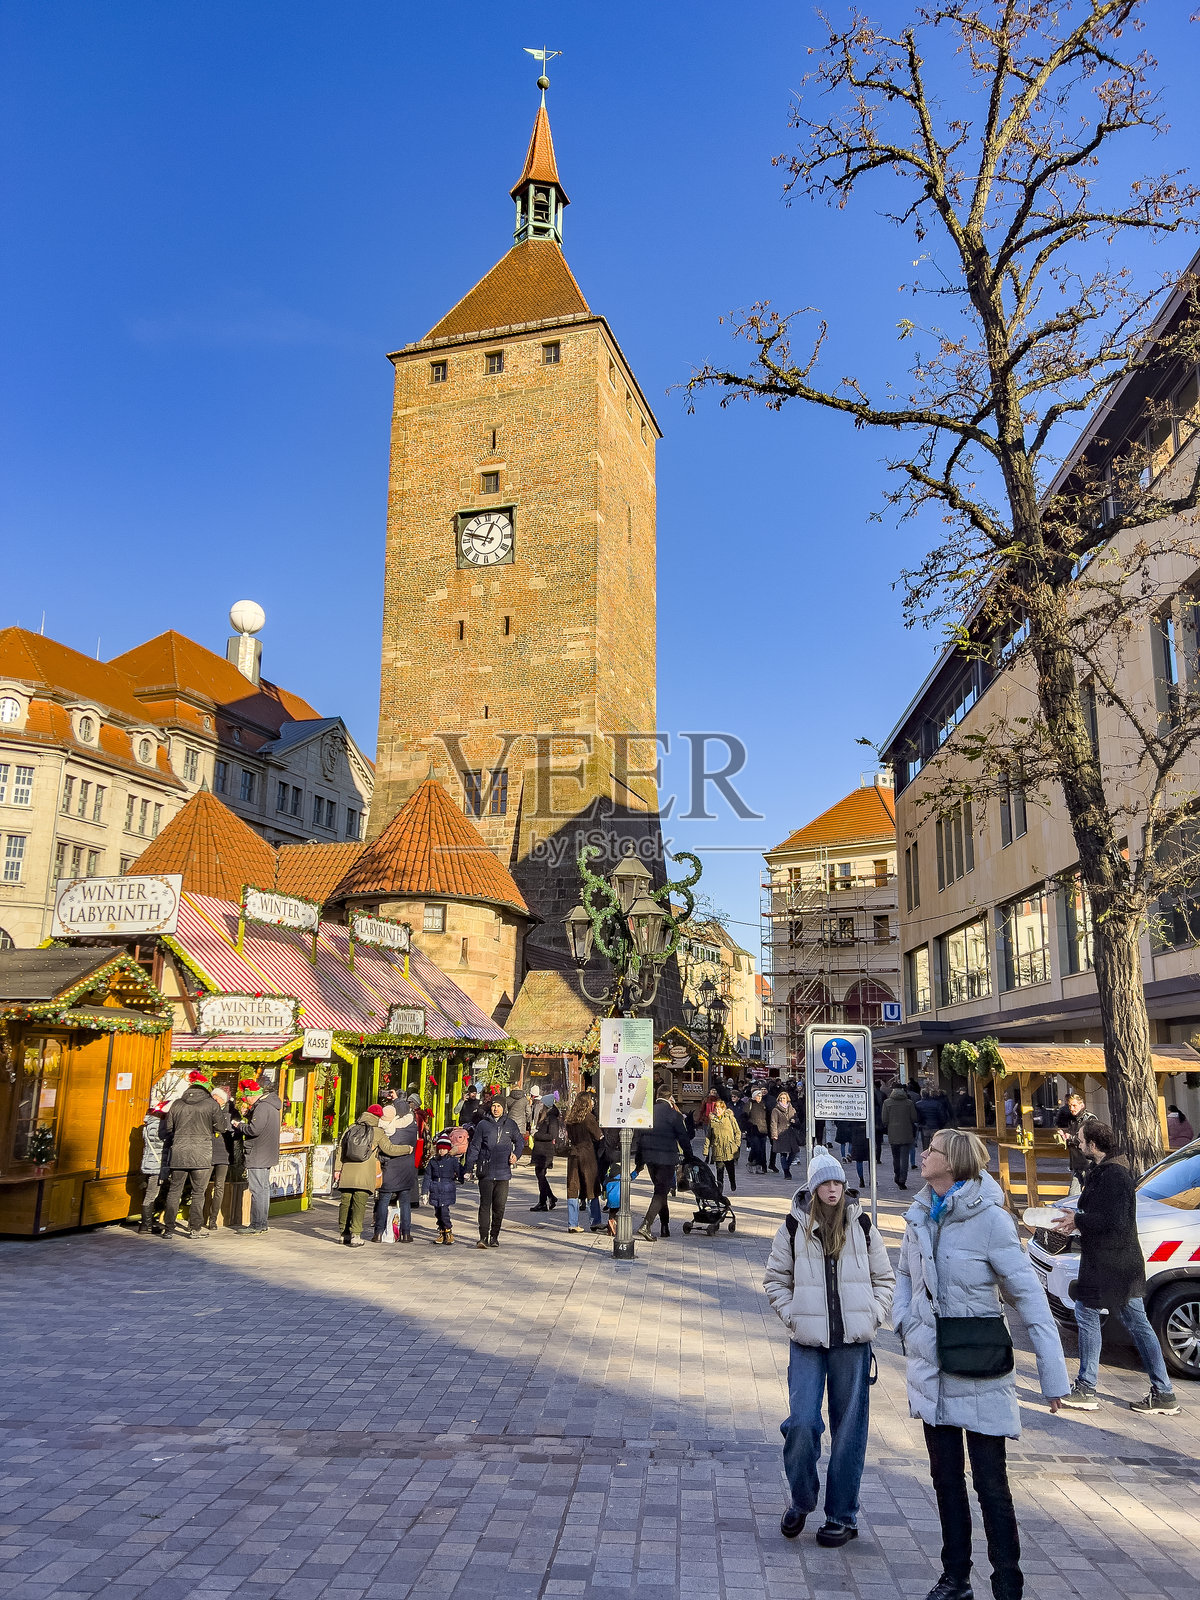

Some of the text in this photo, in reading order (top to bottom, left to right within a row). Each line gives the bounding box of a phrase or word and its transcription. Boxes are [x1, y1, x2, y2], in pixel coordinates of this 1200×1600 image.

[69, 903, 161, 923] LABYRINTH
[360, 920, 403, 942] LABYRINTH
[886, 1005, 899, 1020] U
[212, 1015, 284, 1027] LABYRINTH
[308, 1038, 329, 1049] KASSE
[826, 1075, 853, 1085] ZONE
